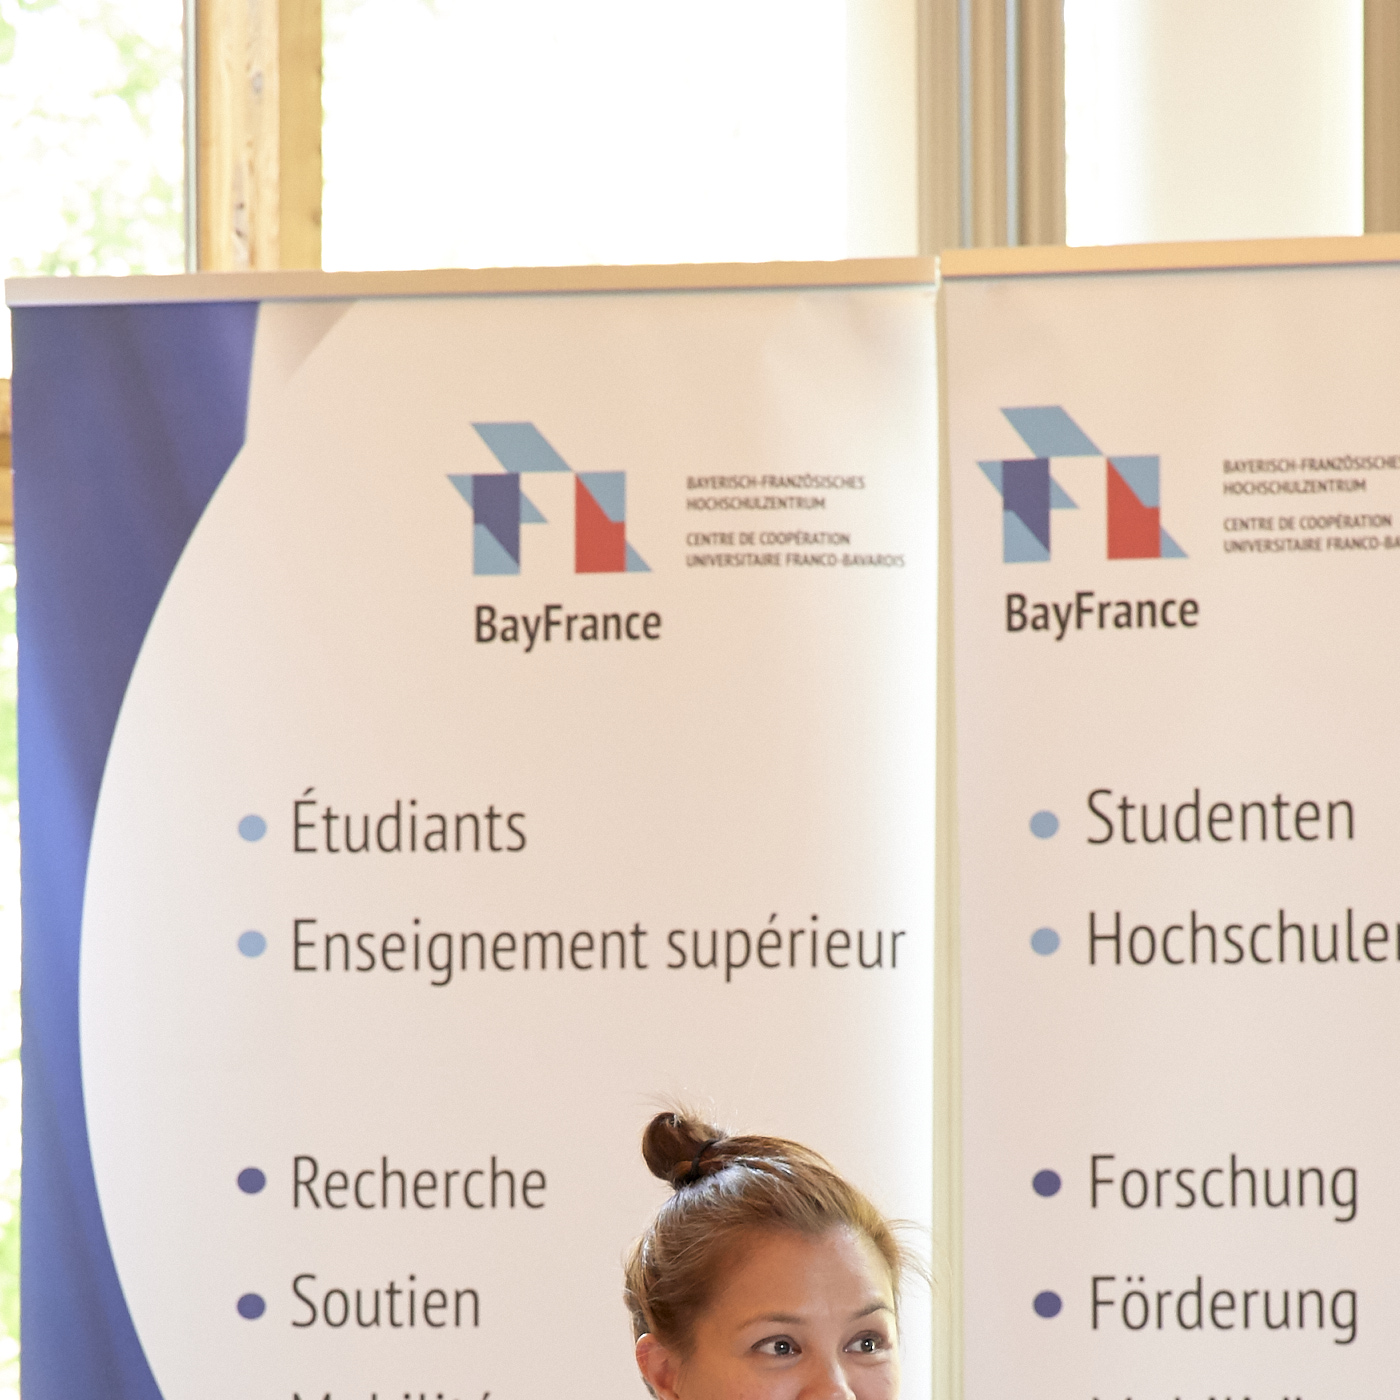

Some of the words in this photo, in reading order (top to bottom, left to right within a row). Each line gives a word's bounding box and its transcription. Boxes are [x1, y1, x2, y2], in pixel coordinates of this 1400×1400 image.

[686, 497, 826, 510] HOCHSCHULZENTRUM
[1223, 478, 1366, 494] HOCHSCHULZENTRUM
[686, 532, 735, 545] CENTRE
[739, 532, 754, 545] DE
[1223, 517, 1274, 531] CENTRE
[1279, 516, 1294, 530] DE
[1223, 537, 1323, 553] UNIVERSITAIRE
[686, 553, 782, 567] UNIVERSITAIRE
[786, 553, 905, 567] FRANCO-BAVAROIS
[475, 603, 662, 653] BayFrance
[1006, 590, 1200, 641] BayFrance
[293, 786, 528, 853] Étudiants
[1086, 787, 1356, 845] Studenten
[292, 917, 649, 988] Enseignement
[666, 912, 906, 984] supérieur
[292, 1154, 547, 1210] Recherche
[1090, 1152, 1359, 1223] Forschung
[291, 1272, 481, 1328] Soutien
[1091, 1274, 1359, 1345] Förderung
